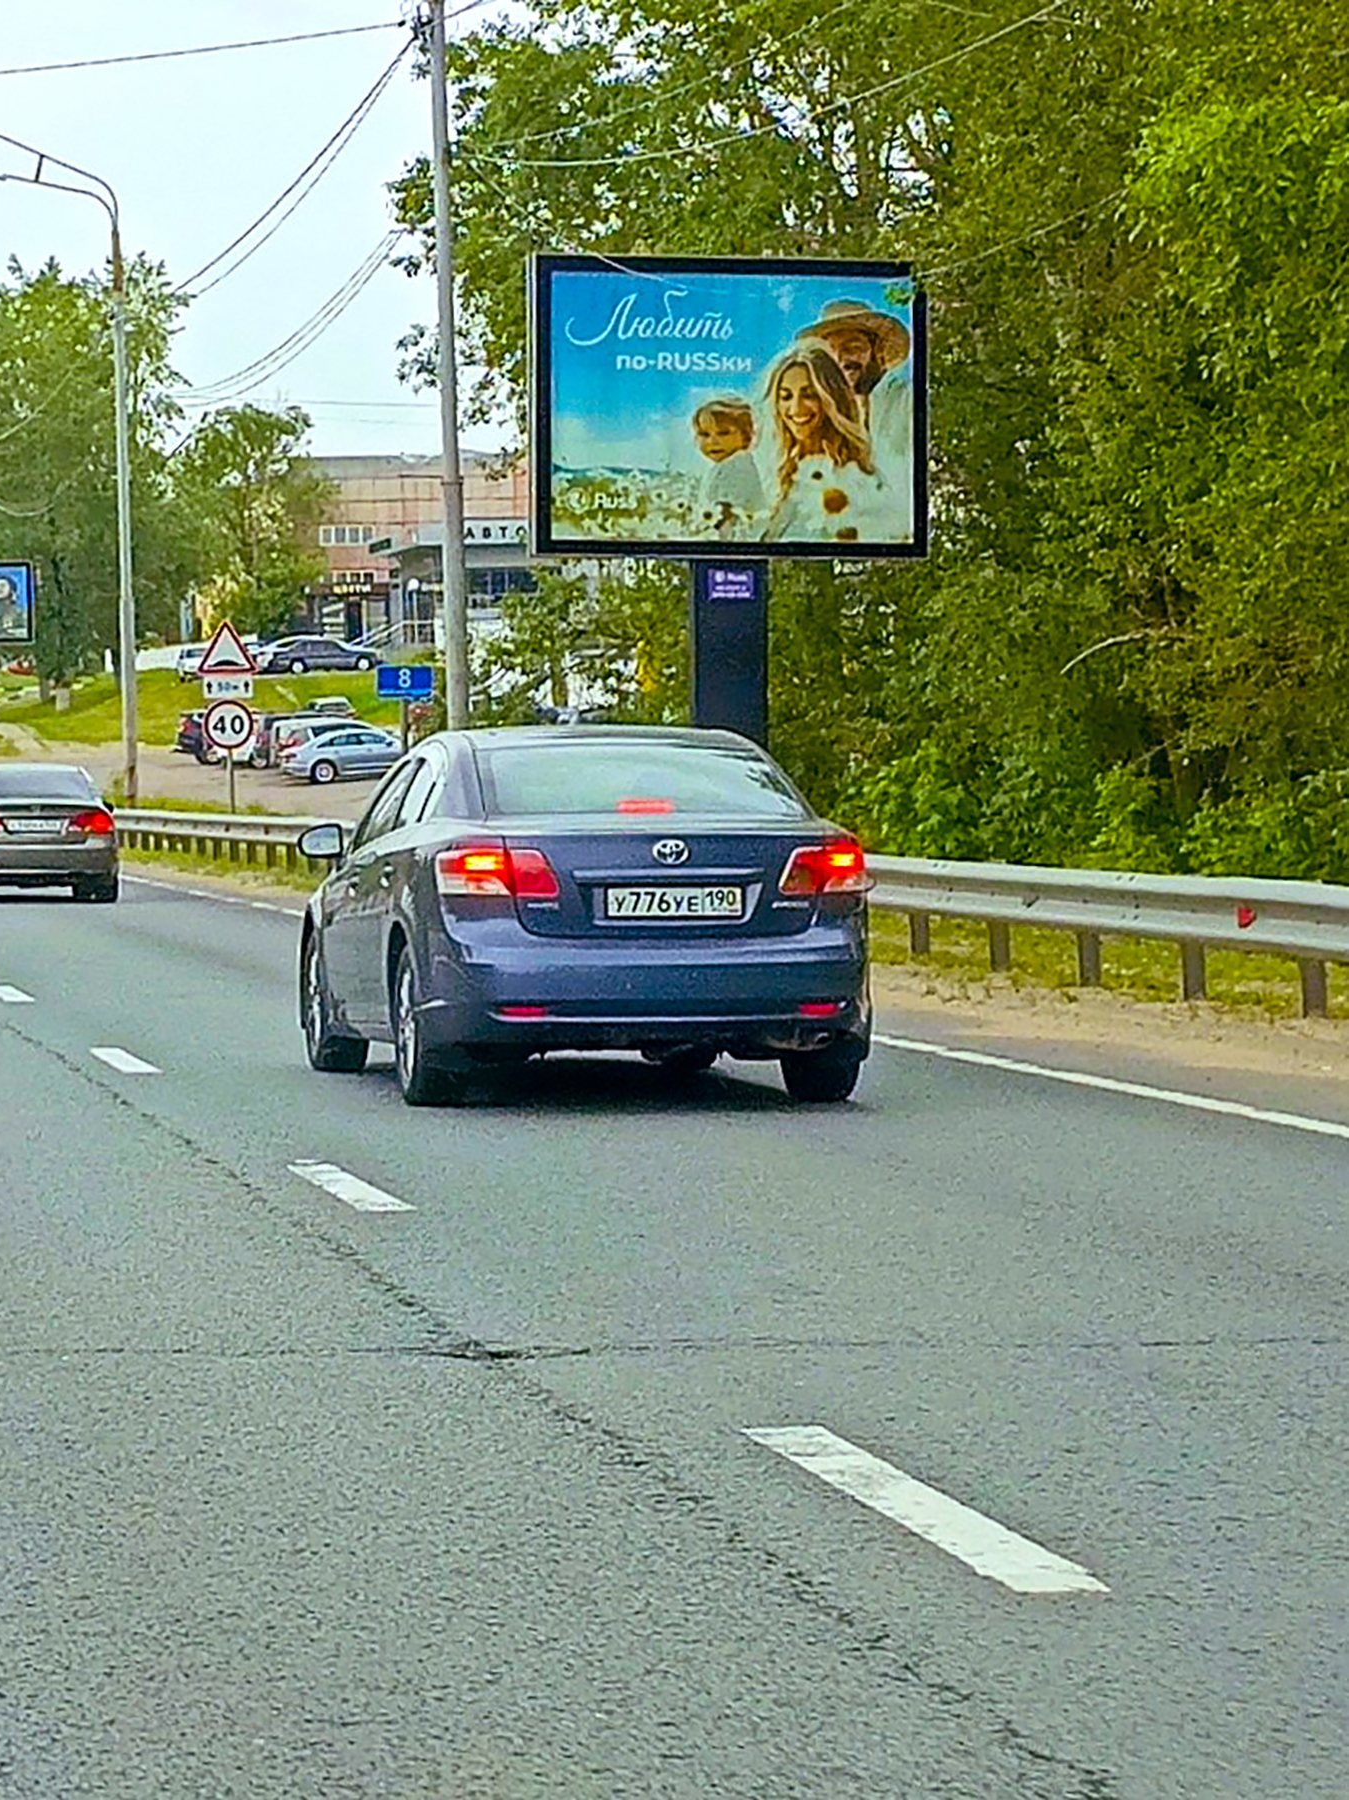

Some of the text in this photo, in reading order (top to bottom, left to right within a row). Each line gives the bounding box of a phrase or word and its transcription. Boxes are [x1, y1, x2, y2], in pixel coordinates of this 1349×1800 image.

[564, 290, 734, 346] Любить
[616, 352, 752, 372] по-RUSSки
[398, 668, 411, 688] 8
[212, 714, 245, 735] 40
[705, 890, 737, 907] 190
